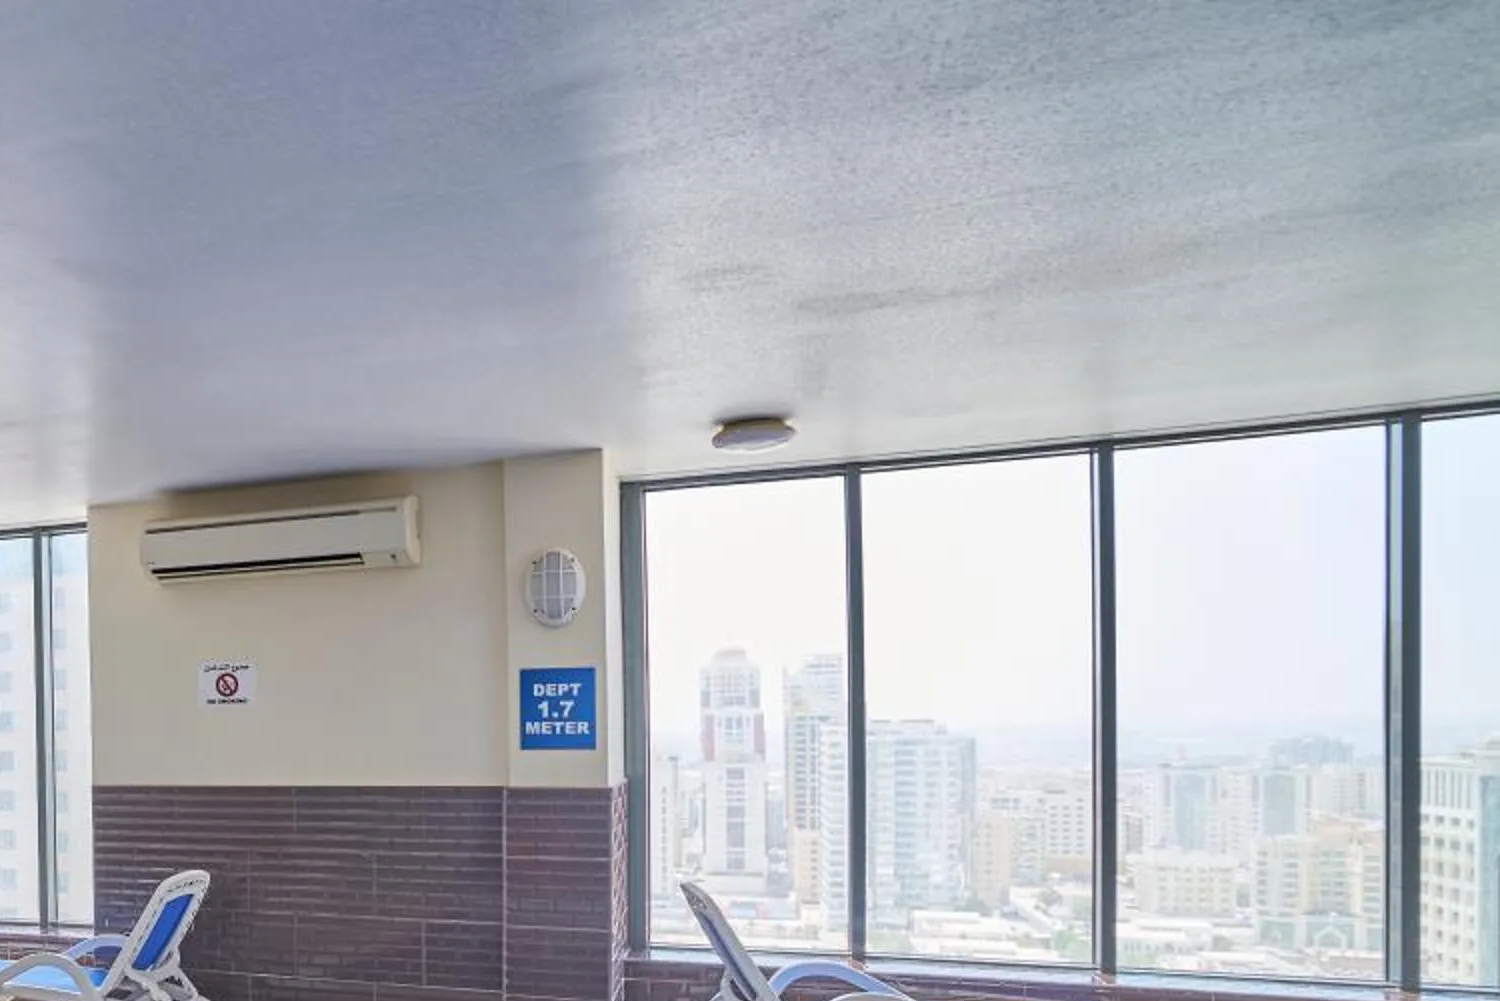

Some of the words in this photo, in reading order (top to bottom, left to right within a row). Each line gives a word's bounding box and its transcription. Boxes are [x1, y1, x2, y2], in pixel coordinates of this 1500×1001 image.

[533, 683, 582, 697] DEPT
[537, 701, 575, 718] 1.7
[525, 721, 590, 735] METER
